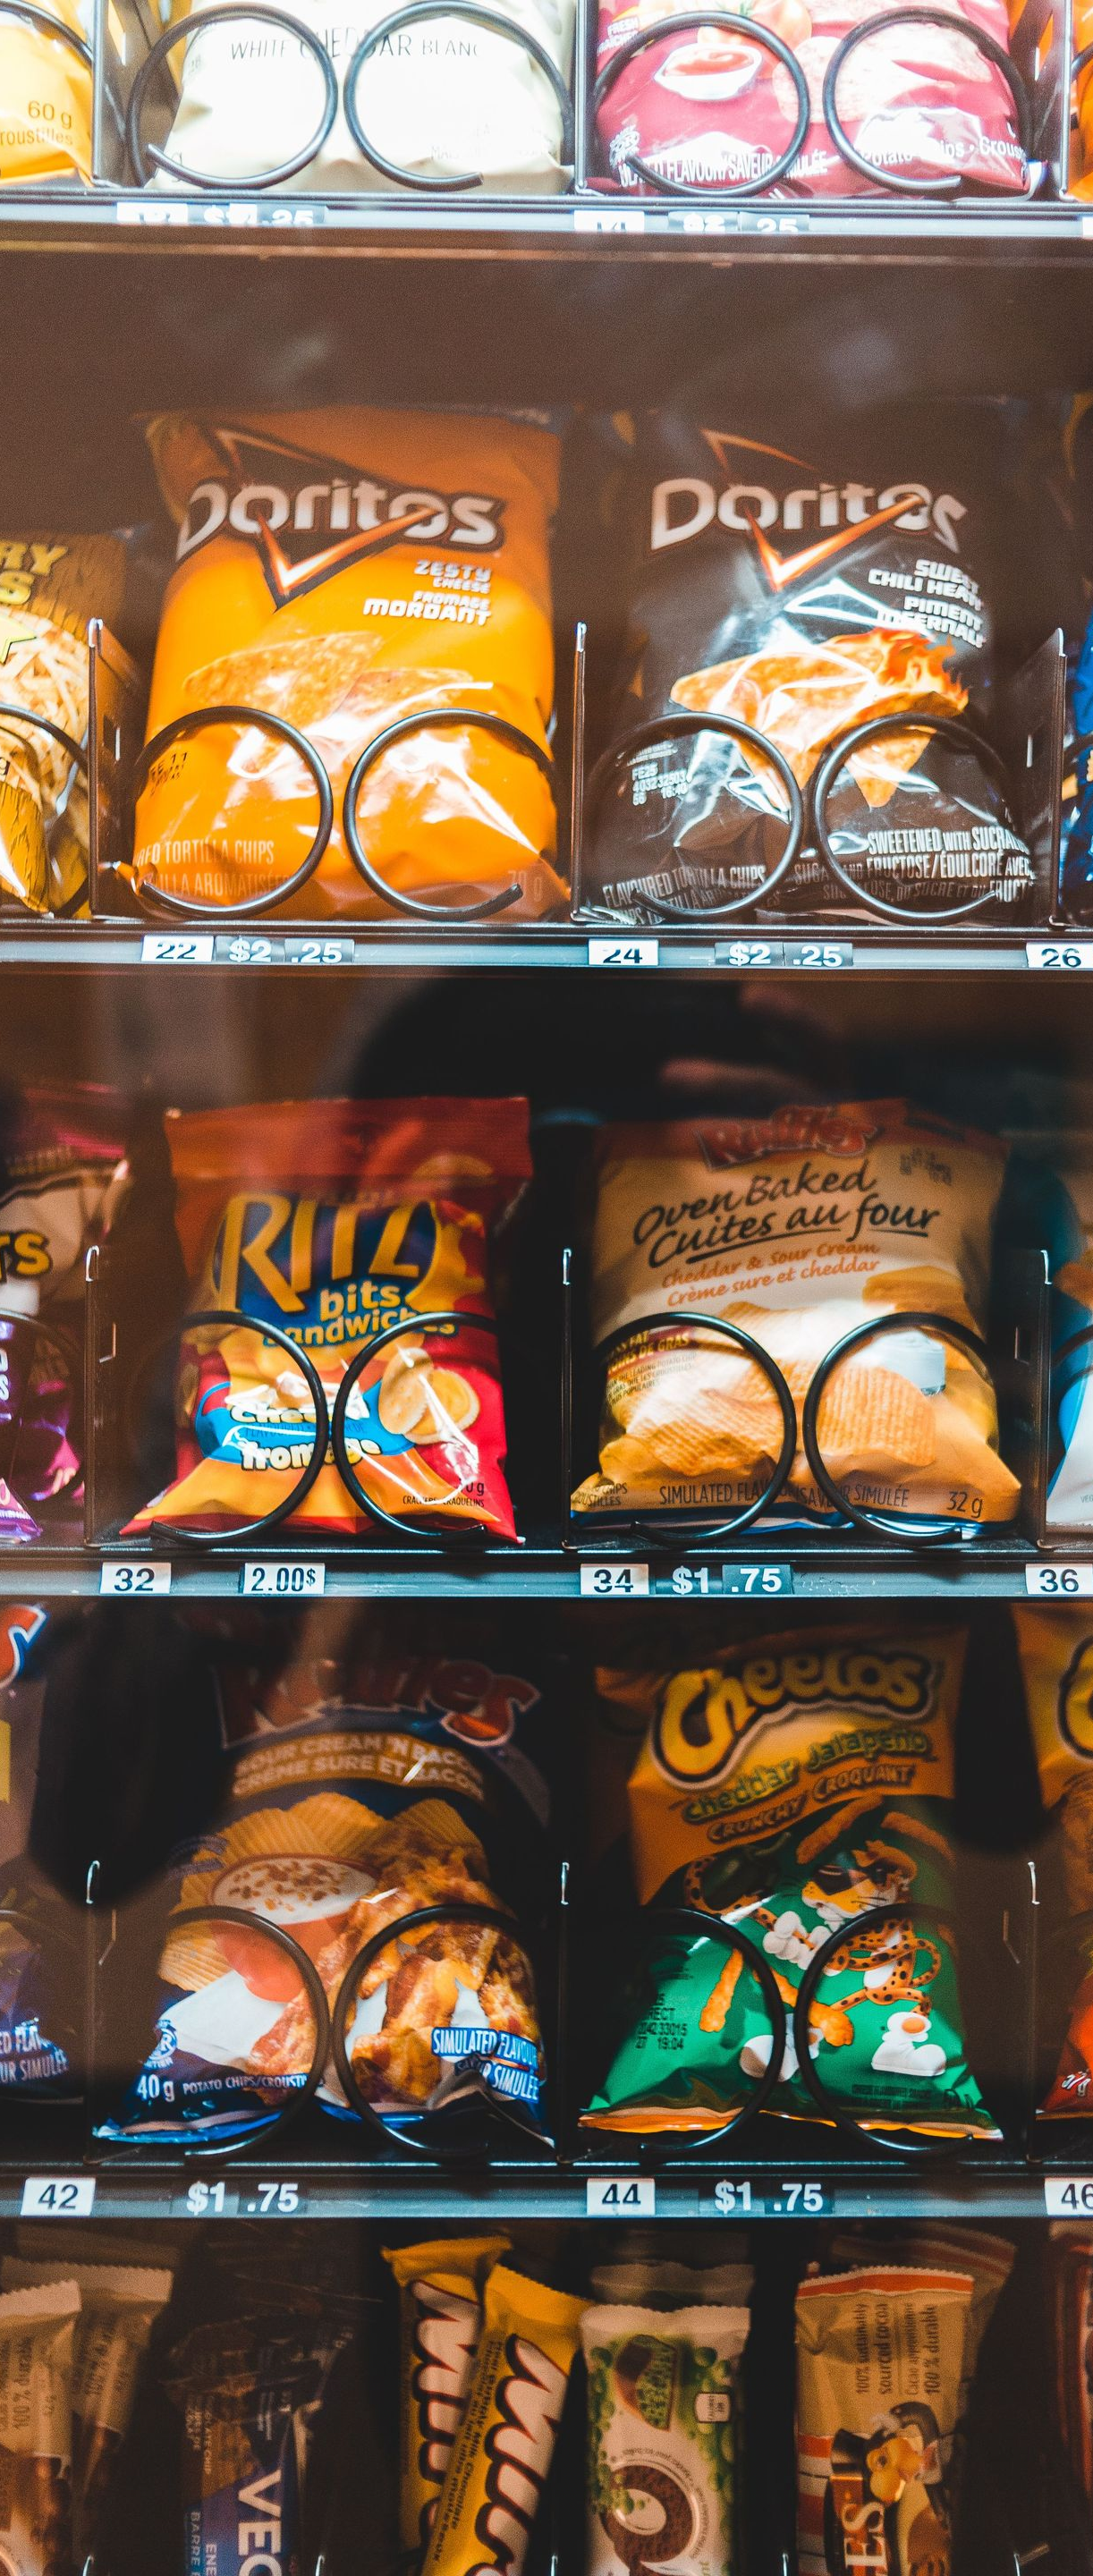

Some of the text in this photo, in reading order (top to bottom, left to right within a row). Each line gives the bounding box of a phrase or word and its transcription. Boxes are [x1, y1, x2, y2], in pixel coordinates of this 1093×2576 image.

[28, 100, 72, 131] 60 g
[177, 477, 498, 563] Doritos
[650, 477, 969, 555] Doritos
[413, 559, 492, 582] ZESTY
[868, 568, 925, 592] CHILI
[913, 559, 979, 594] SWEET
[432, 576, 492, 594] CHEESE
[362, 597, 493, 626] MORDANT
[412, 590, 491, 611] FROMAGE
[903, 596, 985, 631] PIMENT
[165, 838, 275, 865] TORTILLA CHIPS
[868, 827, 971, 855] SWEETENED WITH
[729, 865, 767, 888] CHIPS
[156, 936, 343, 963] 22 $2 .25
[603, 940, 843, 967] 24 $2 .25
[1041, 948, 1081, 968] 26
[633, 1187, 741, 1246] Oven
[744, 1159, 877, 1209] Baked
[648, 1192, 941, 1268] Cuites au four
[219, 1191, 421, 1314] RITZ
[746, 1256, 764, 1270] &
[816, 1241, 881, 1258] Cream
[666, 1255, 881, 1307] Crème sure et cheddar
[319, 1279, 402, 1322] bits
[657, 1333, 690, 1352] GRAS
[659, 1483, 983, 1519] SIMULATED SIMULÉE 32 g
[114, 1567, 317, 1592] 32 2.00$
[593, 1565, 784, 1595] 34 $1 .75
[1039, 1569, 1079, 1592] 36
[659, 1652, 927, 1776] Cheetos
[300, 1736, 383, 1755] CREAM
[313, 1755, 376, 1774] SURE
[378, 1757, 406, 1776] ET
[812, 1762, 917, 1803] CROQUANT
[433, 2029, 498, 2055] SIMULATED
[137, 2074, 160, 2101] 40
[163, 2080, 175, 2102] g
[182, 2079, 223, 2096] POTATO
[38, 2181, 300, 2216] 42 $1 .75
[602, 2179, 824, 2215] 44 $1 .75
[855, 2366, 869, 2394] 100%
[873, 2342, 893, 2395] sourced
[923, 2371, 941, 2394] 100
